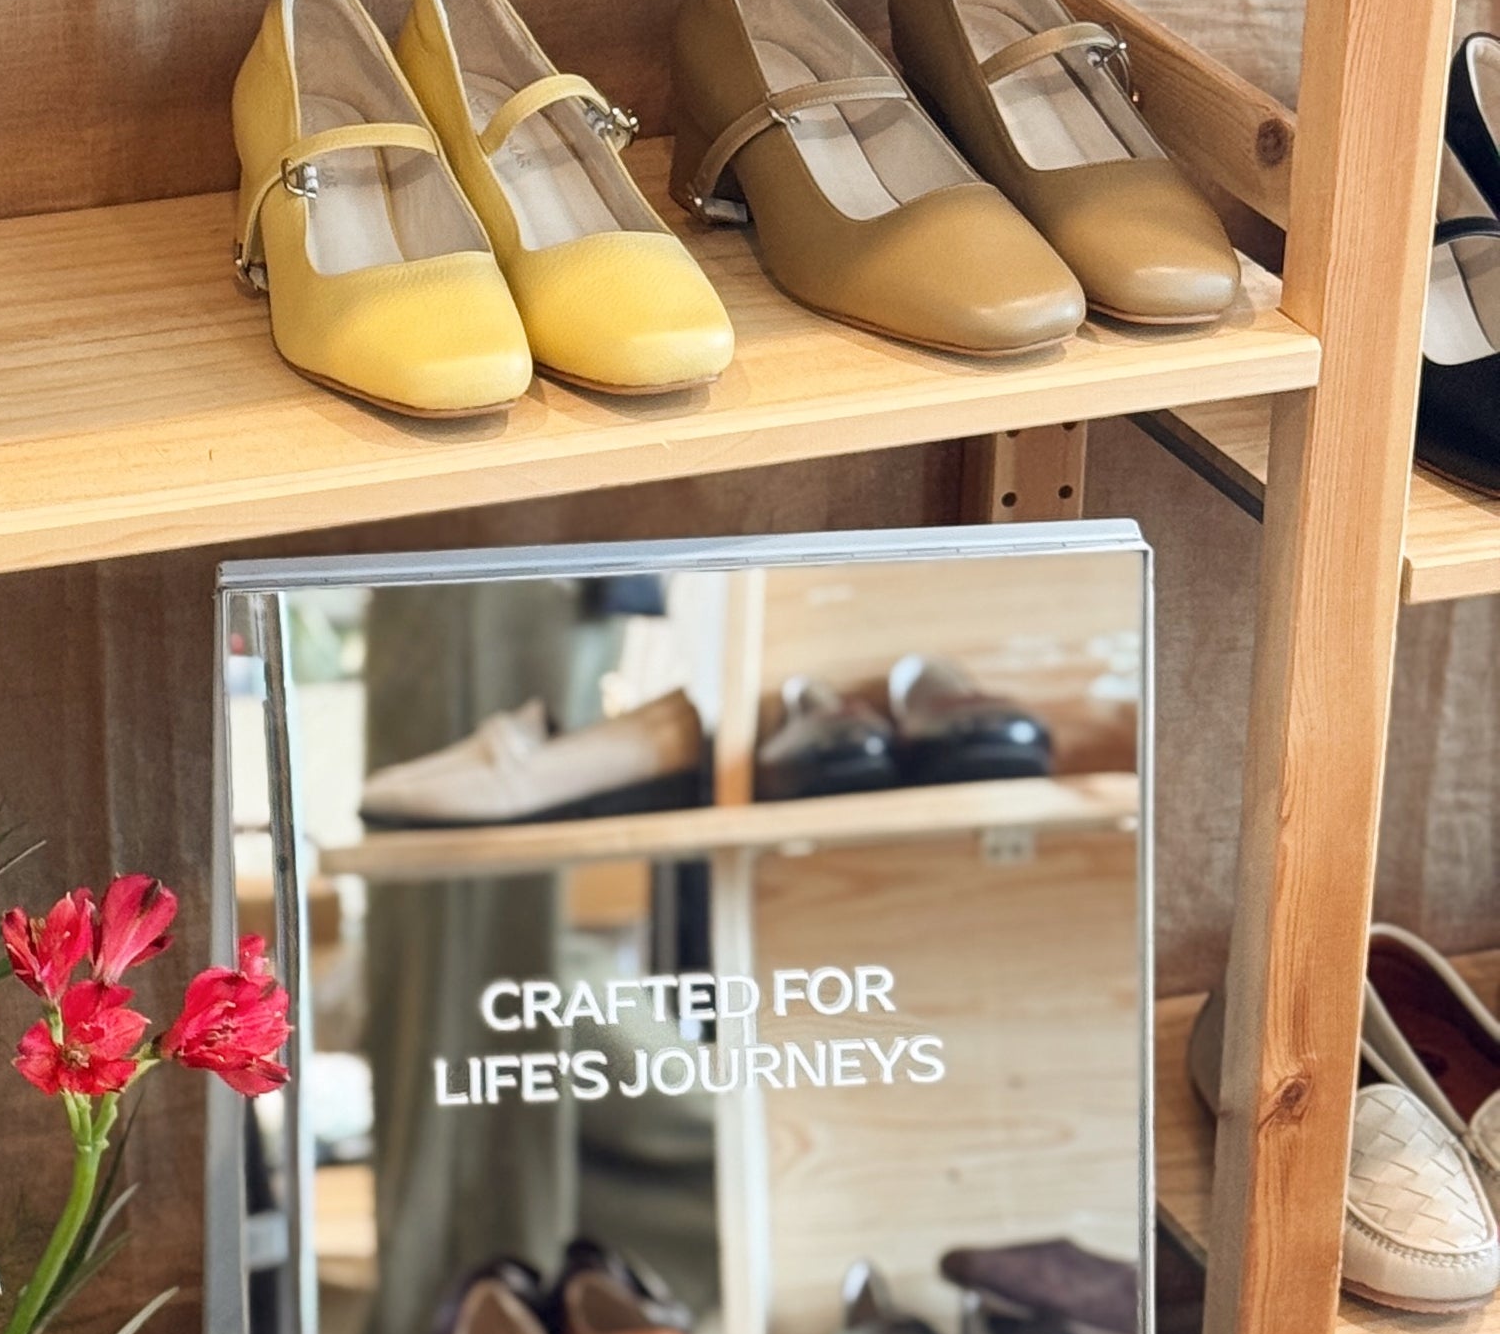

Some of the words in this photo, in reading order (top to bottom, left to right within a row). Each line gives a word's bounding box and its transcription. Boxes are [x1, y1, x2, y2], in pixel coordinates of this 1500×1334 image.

[480, 973, 760, 1031] CRAFTED
[772, 965, 896, 1017] FOR
[433, 1049, 610, 1106] LIFE'S
[618, 1035, 947, 1099] JOURNEYS
